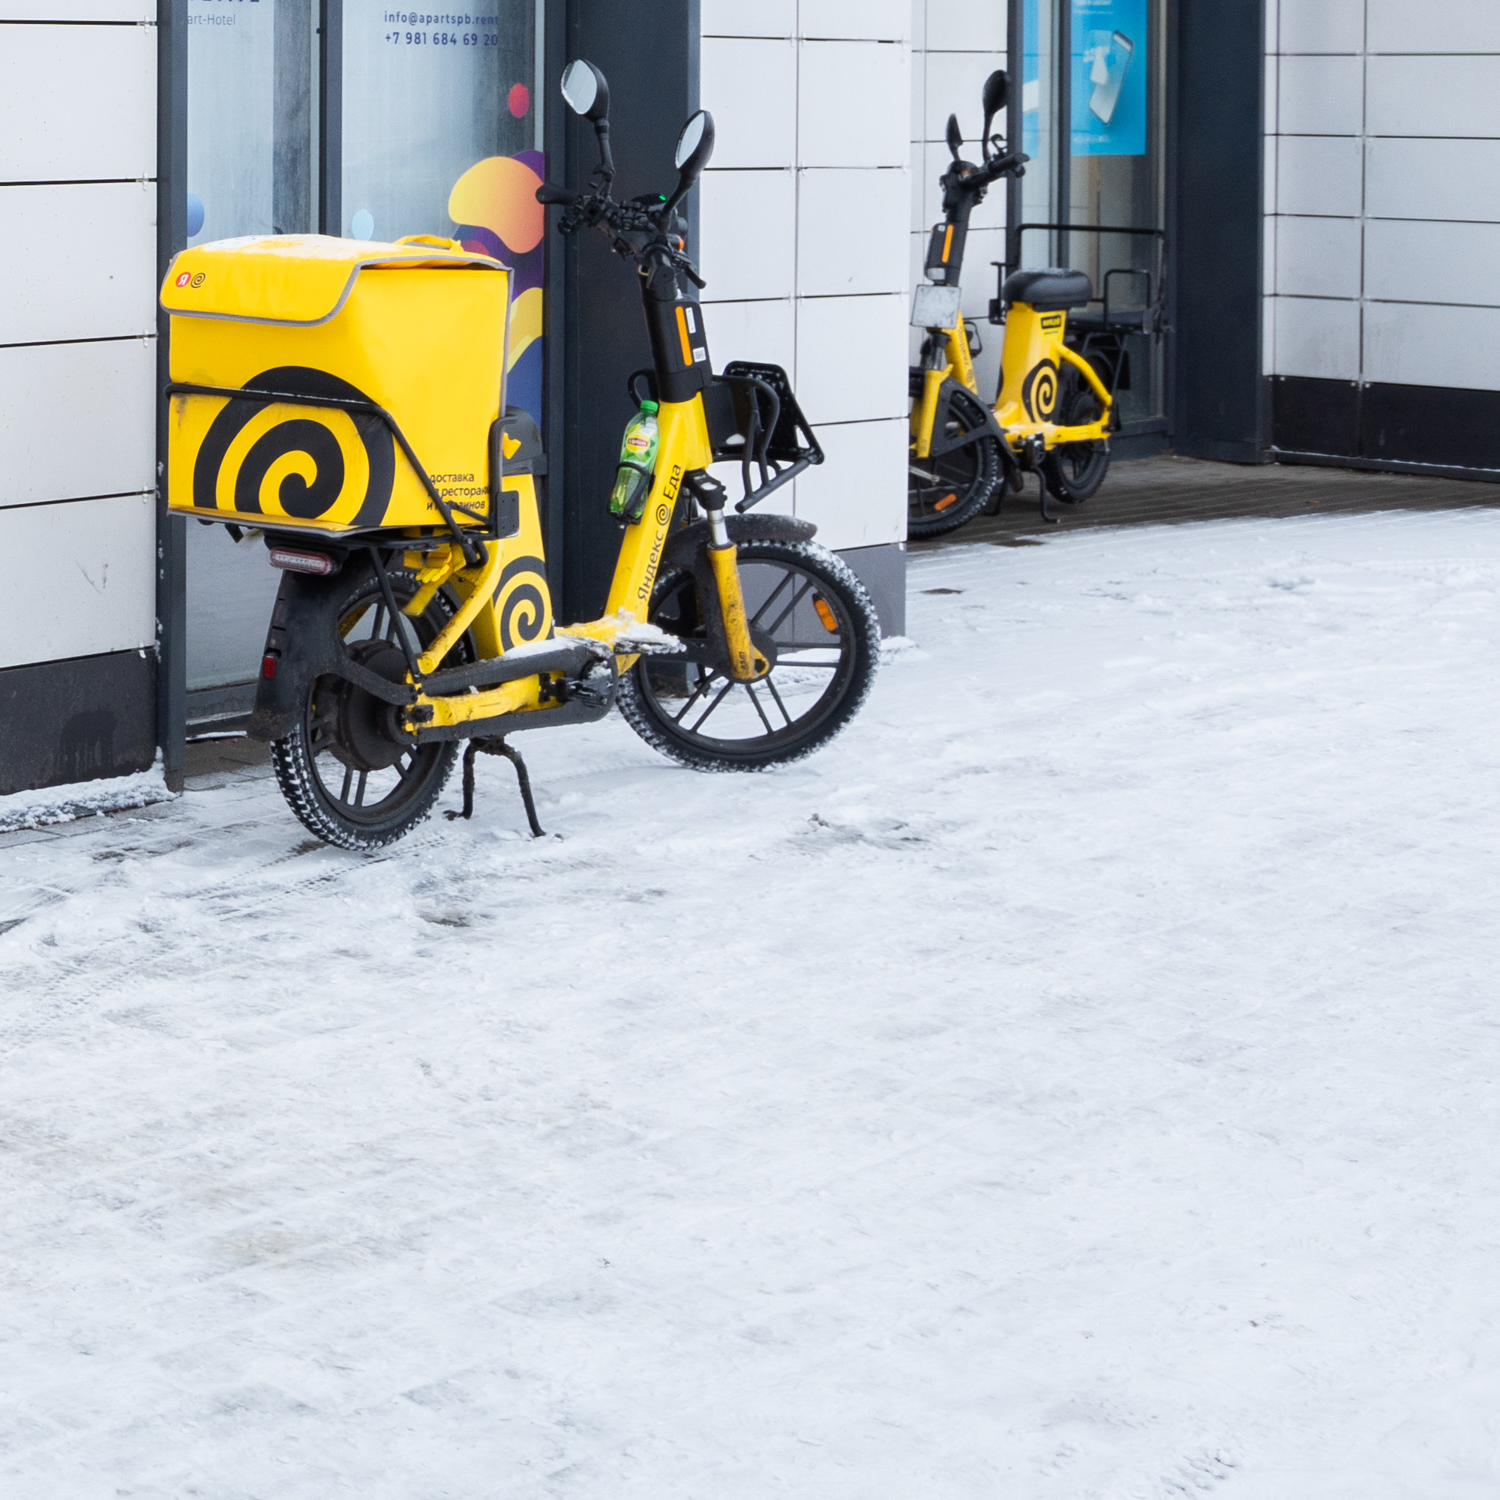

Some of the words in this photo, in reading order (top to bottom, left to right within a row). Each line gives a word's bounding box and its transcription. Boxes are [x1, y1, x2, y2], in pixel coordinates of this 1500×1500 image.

[384, 10, 499, 27] info@apartspb.rent
[385, 32, 400, 45] +7
[406, 32, 427, 45] 981
[433, 33, 457, 45] 684
[463, 33, 478, 46] 69
[483, 34, 499, 46] 20
[430, 474, 475, 484] доставка
[638, 530, 664, 600] Яндекс
[663, 464, 682, 500] Еда
